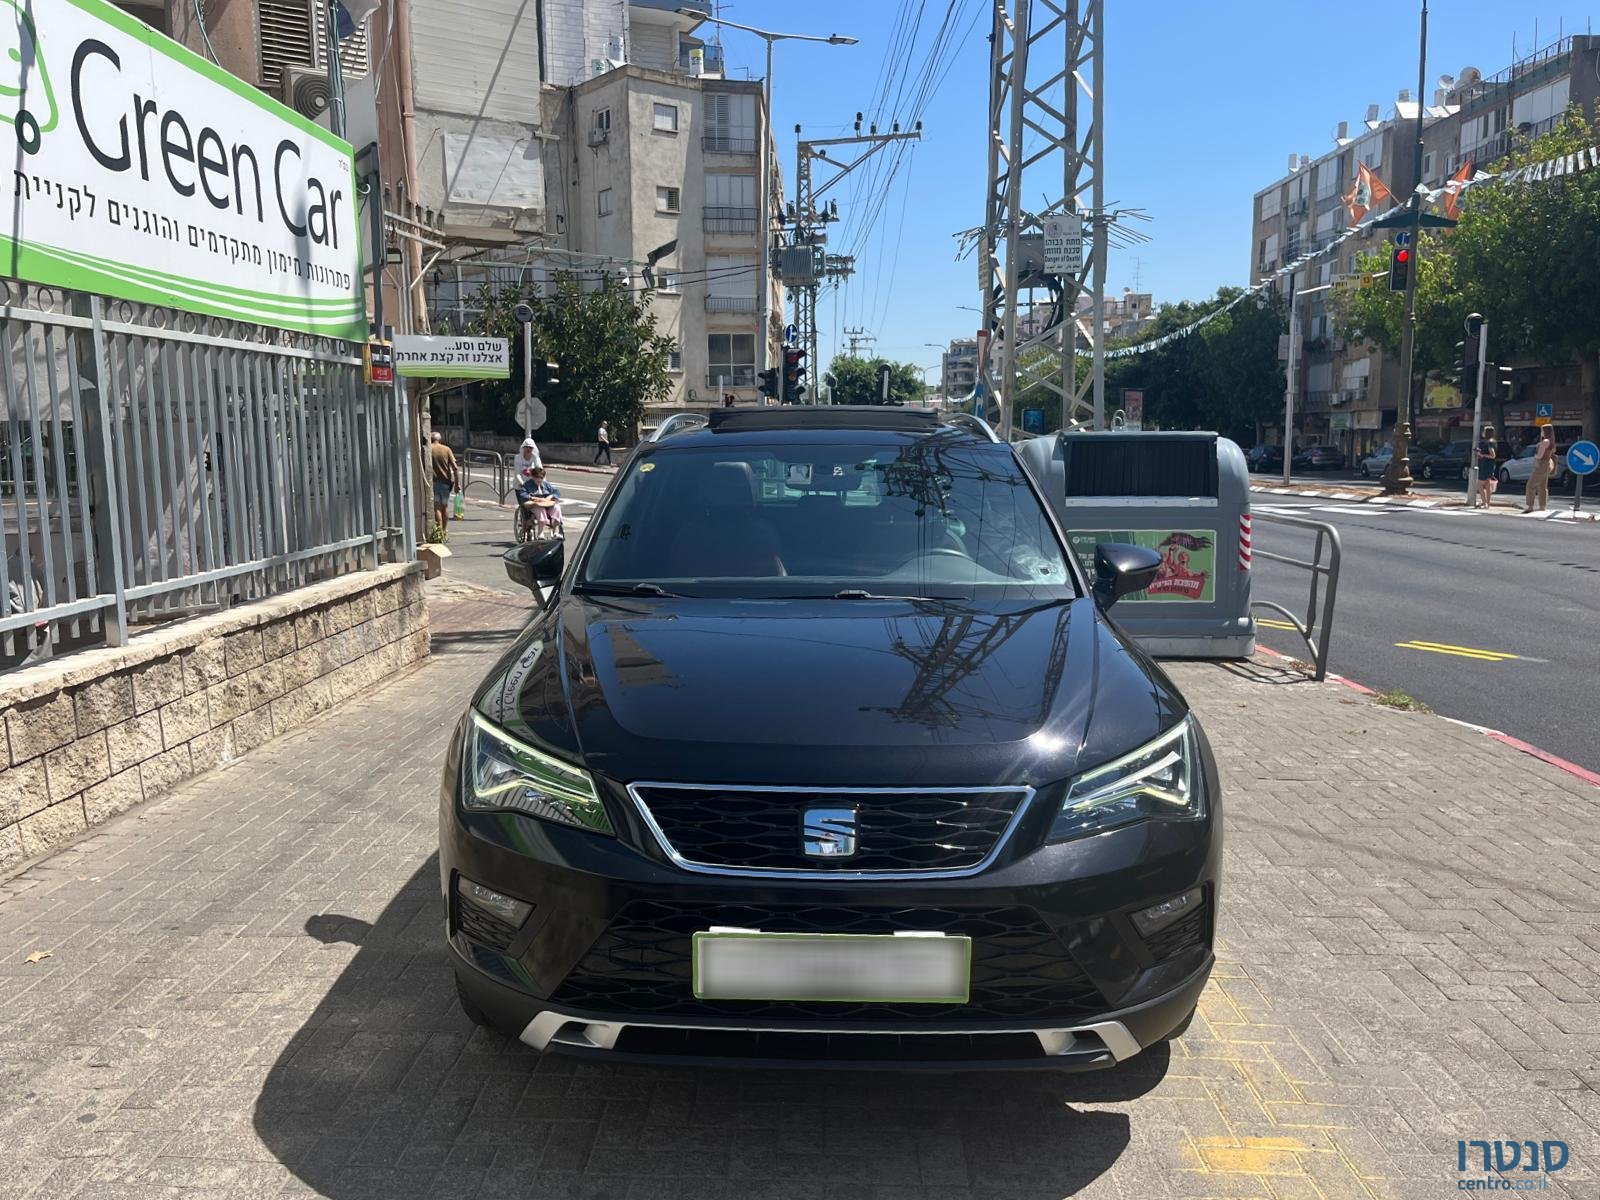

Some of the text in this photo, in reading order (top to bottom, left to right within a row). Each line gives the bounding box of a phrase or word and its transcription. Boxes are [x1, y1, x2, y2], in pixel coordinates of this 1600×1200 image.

[70, 37, 342, 250] Green Car
[13, 169, 351, 290] פתרונות מימון מתקדמים והוגנים לקניית
[1044, 255, 1060, 263] Danger
[444, 341, 502, 352] שלם וסע...
[396, 351, 503, 365] אצלנו זה קצת אחרת
